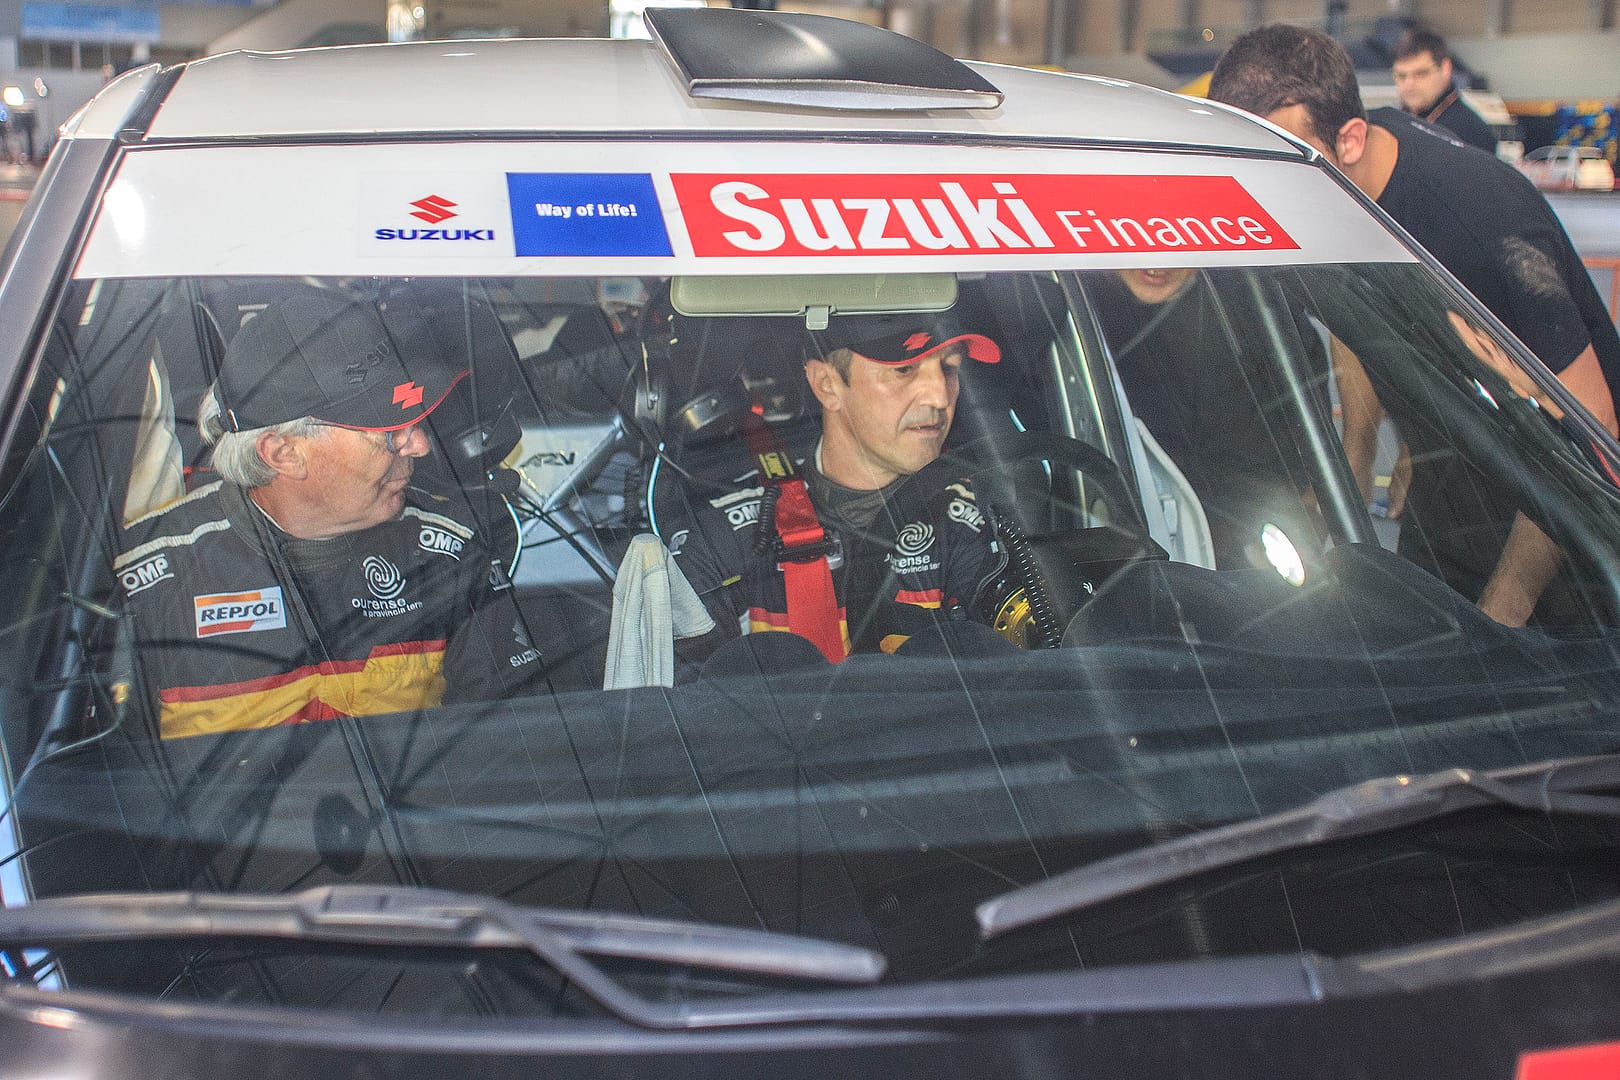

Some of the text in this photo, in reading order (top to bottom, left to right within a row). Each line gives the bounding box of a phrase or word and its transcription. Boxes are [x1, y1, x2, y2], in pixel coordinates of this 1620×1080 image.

[535, 203, 638, 218] Way of Life!
[709, 181, 1274, 252] Suzuki Finance
[375, 228, 496, 241] SUZUKI
[419, 529, 463, 553] OMP
[122, 557, 169, 590] OMP
[201, 600, 279, 622] REPSOL
[352, 598, 407, 611] ourense
